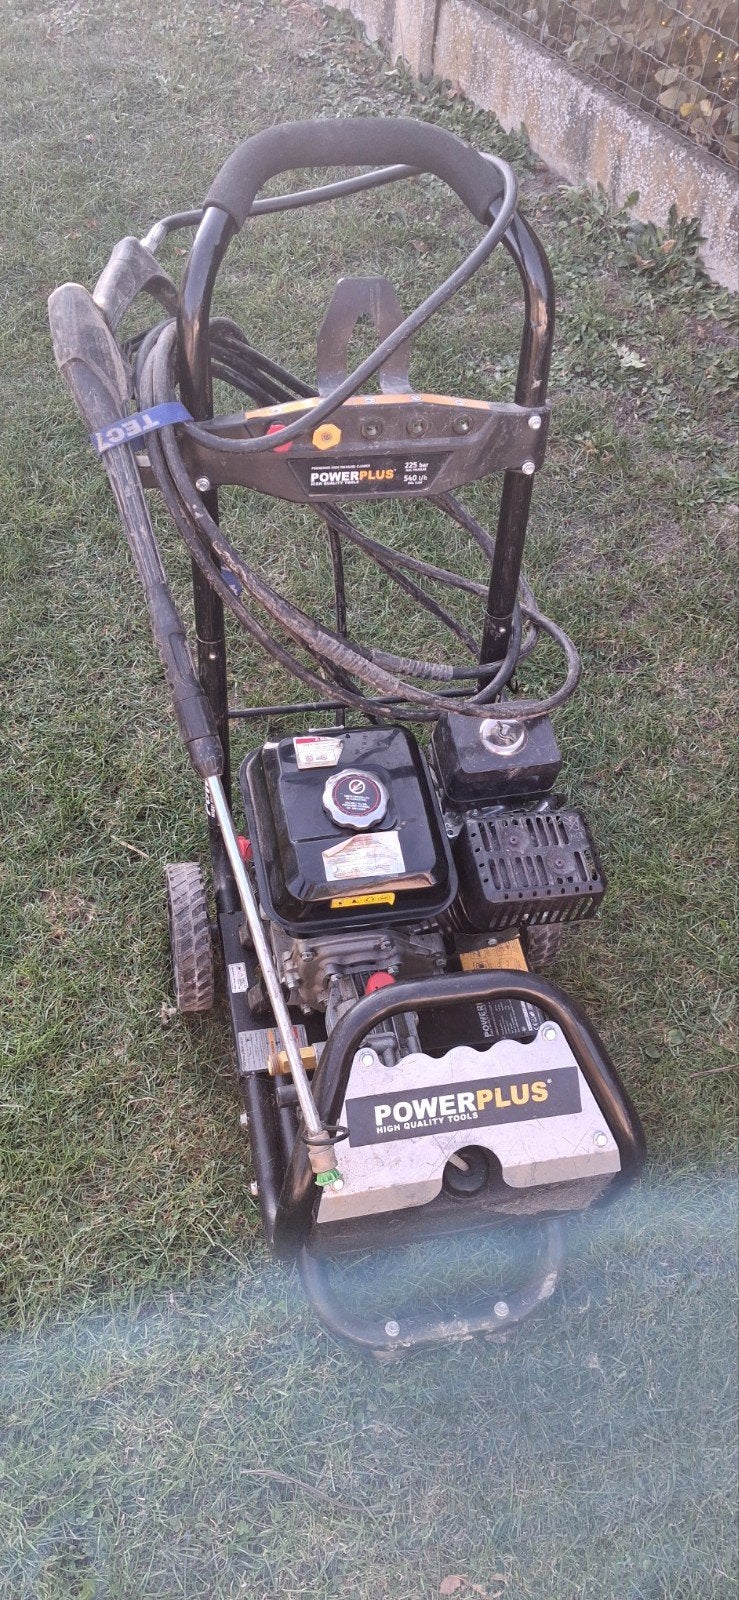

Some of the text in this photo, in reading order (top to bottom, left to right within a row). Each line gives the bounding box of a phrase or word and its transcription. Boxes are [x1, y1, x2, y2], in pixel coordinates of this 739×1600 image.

[404, 461, 418, 469] 225
[310, 468, 395, 482] POWERPLUS
[403, 474, 418, 482] 540
[374, 1081, 549, 1126] POWERPLUS
[376, 1111, 478, 1134] HIGH QUALITY TOOLS
